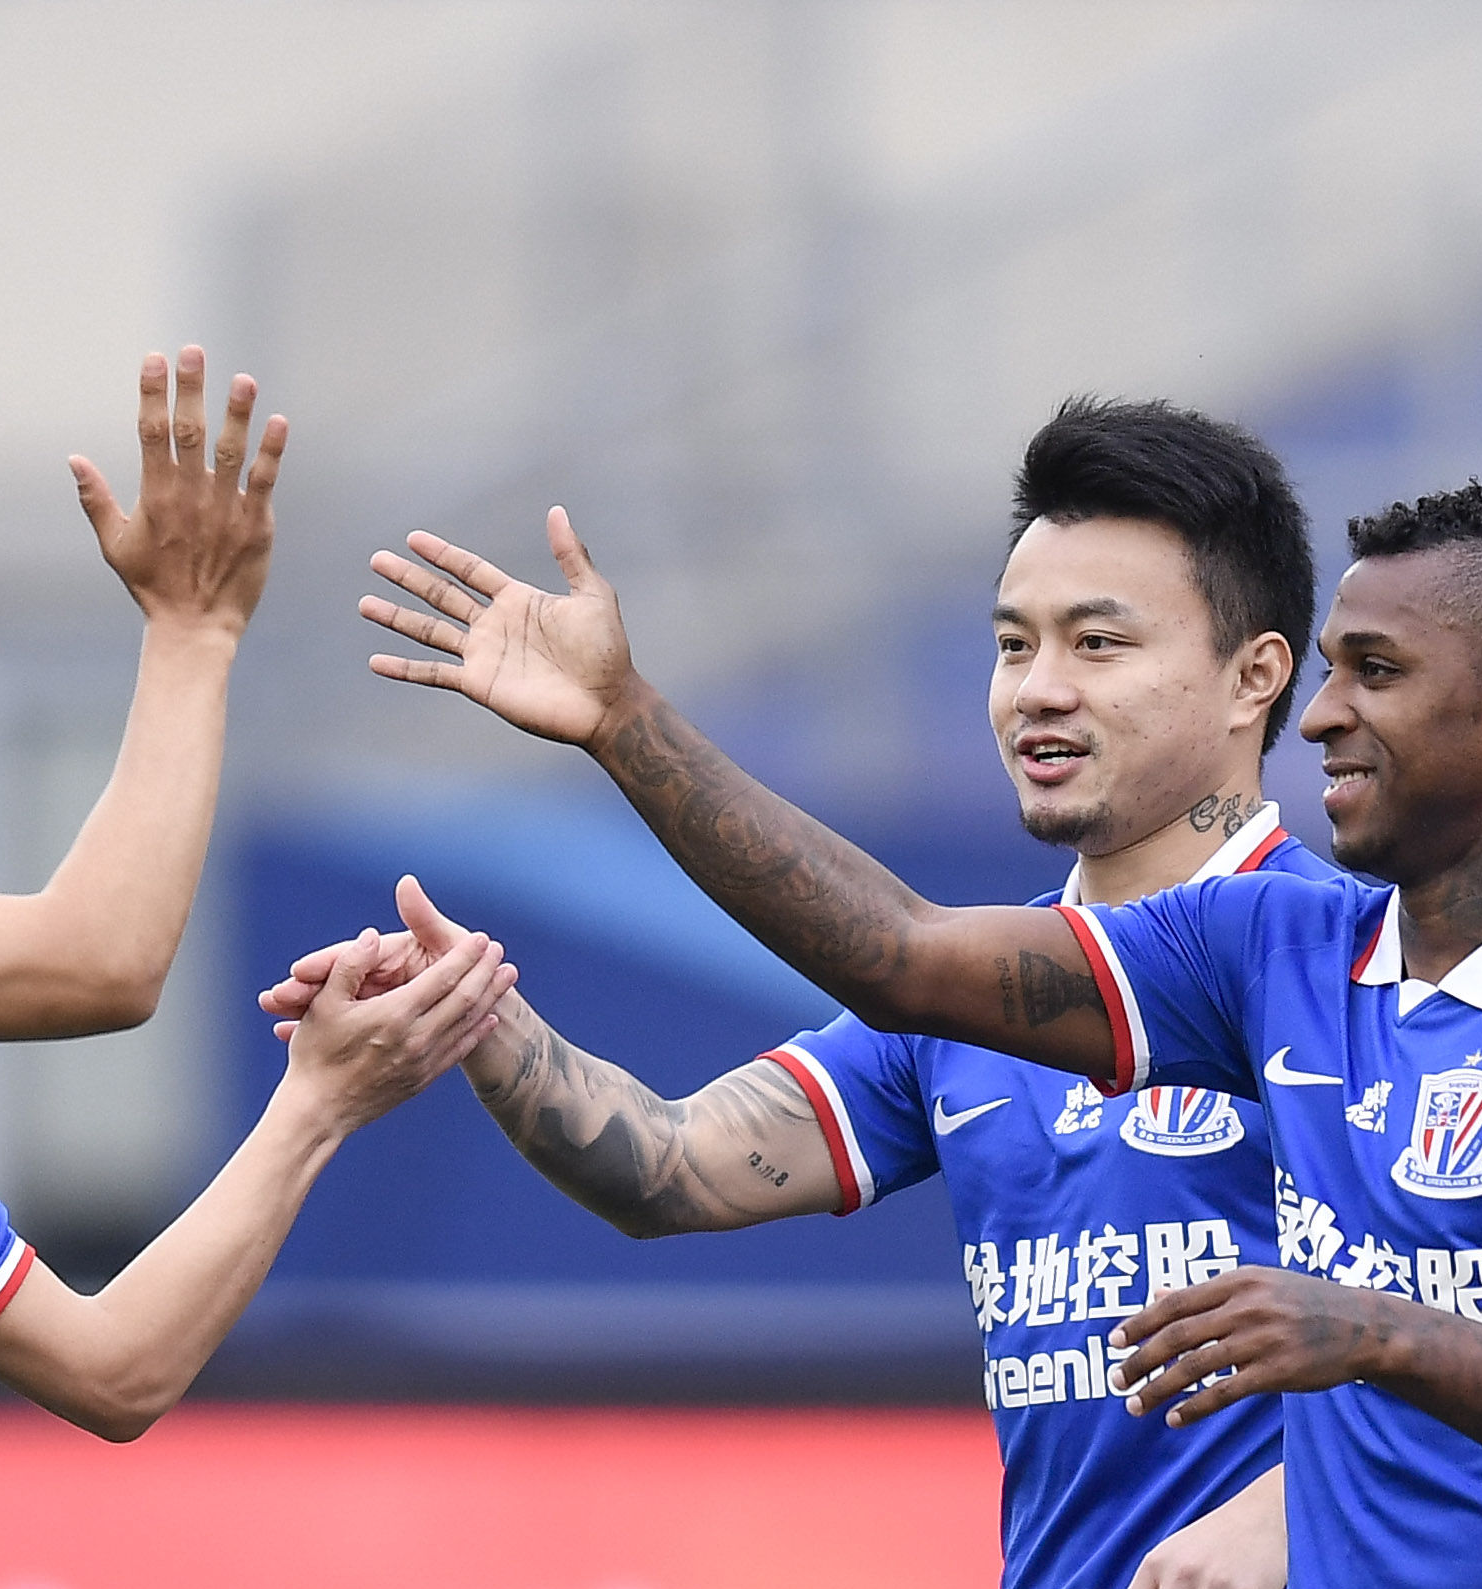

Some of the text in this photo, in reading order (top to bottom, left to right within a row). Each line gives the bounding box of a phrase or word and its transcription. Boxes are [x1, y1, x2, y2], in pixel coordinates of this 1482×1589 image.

[1427, 1115, 1458, 1127] SFC
[964, 1218, 1240, 1333] 绿地控股
